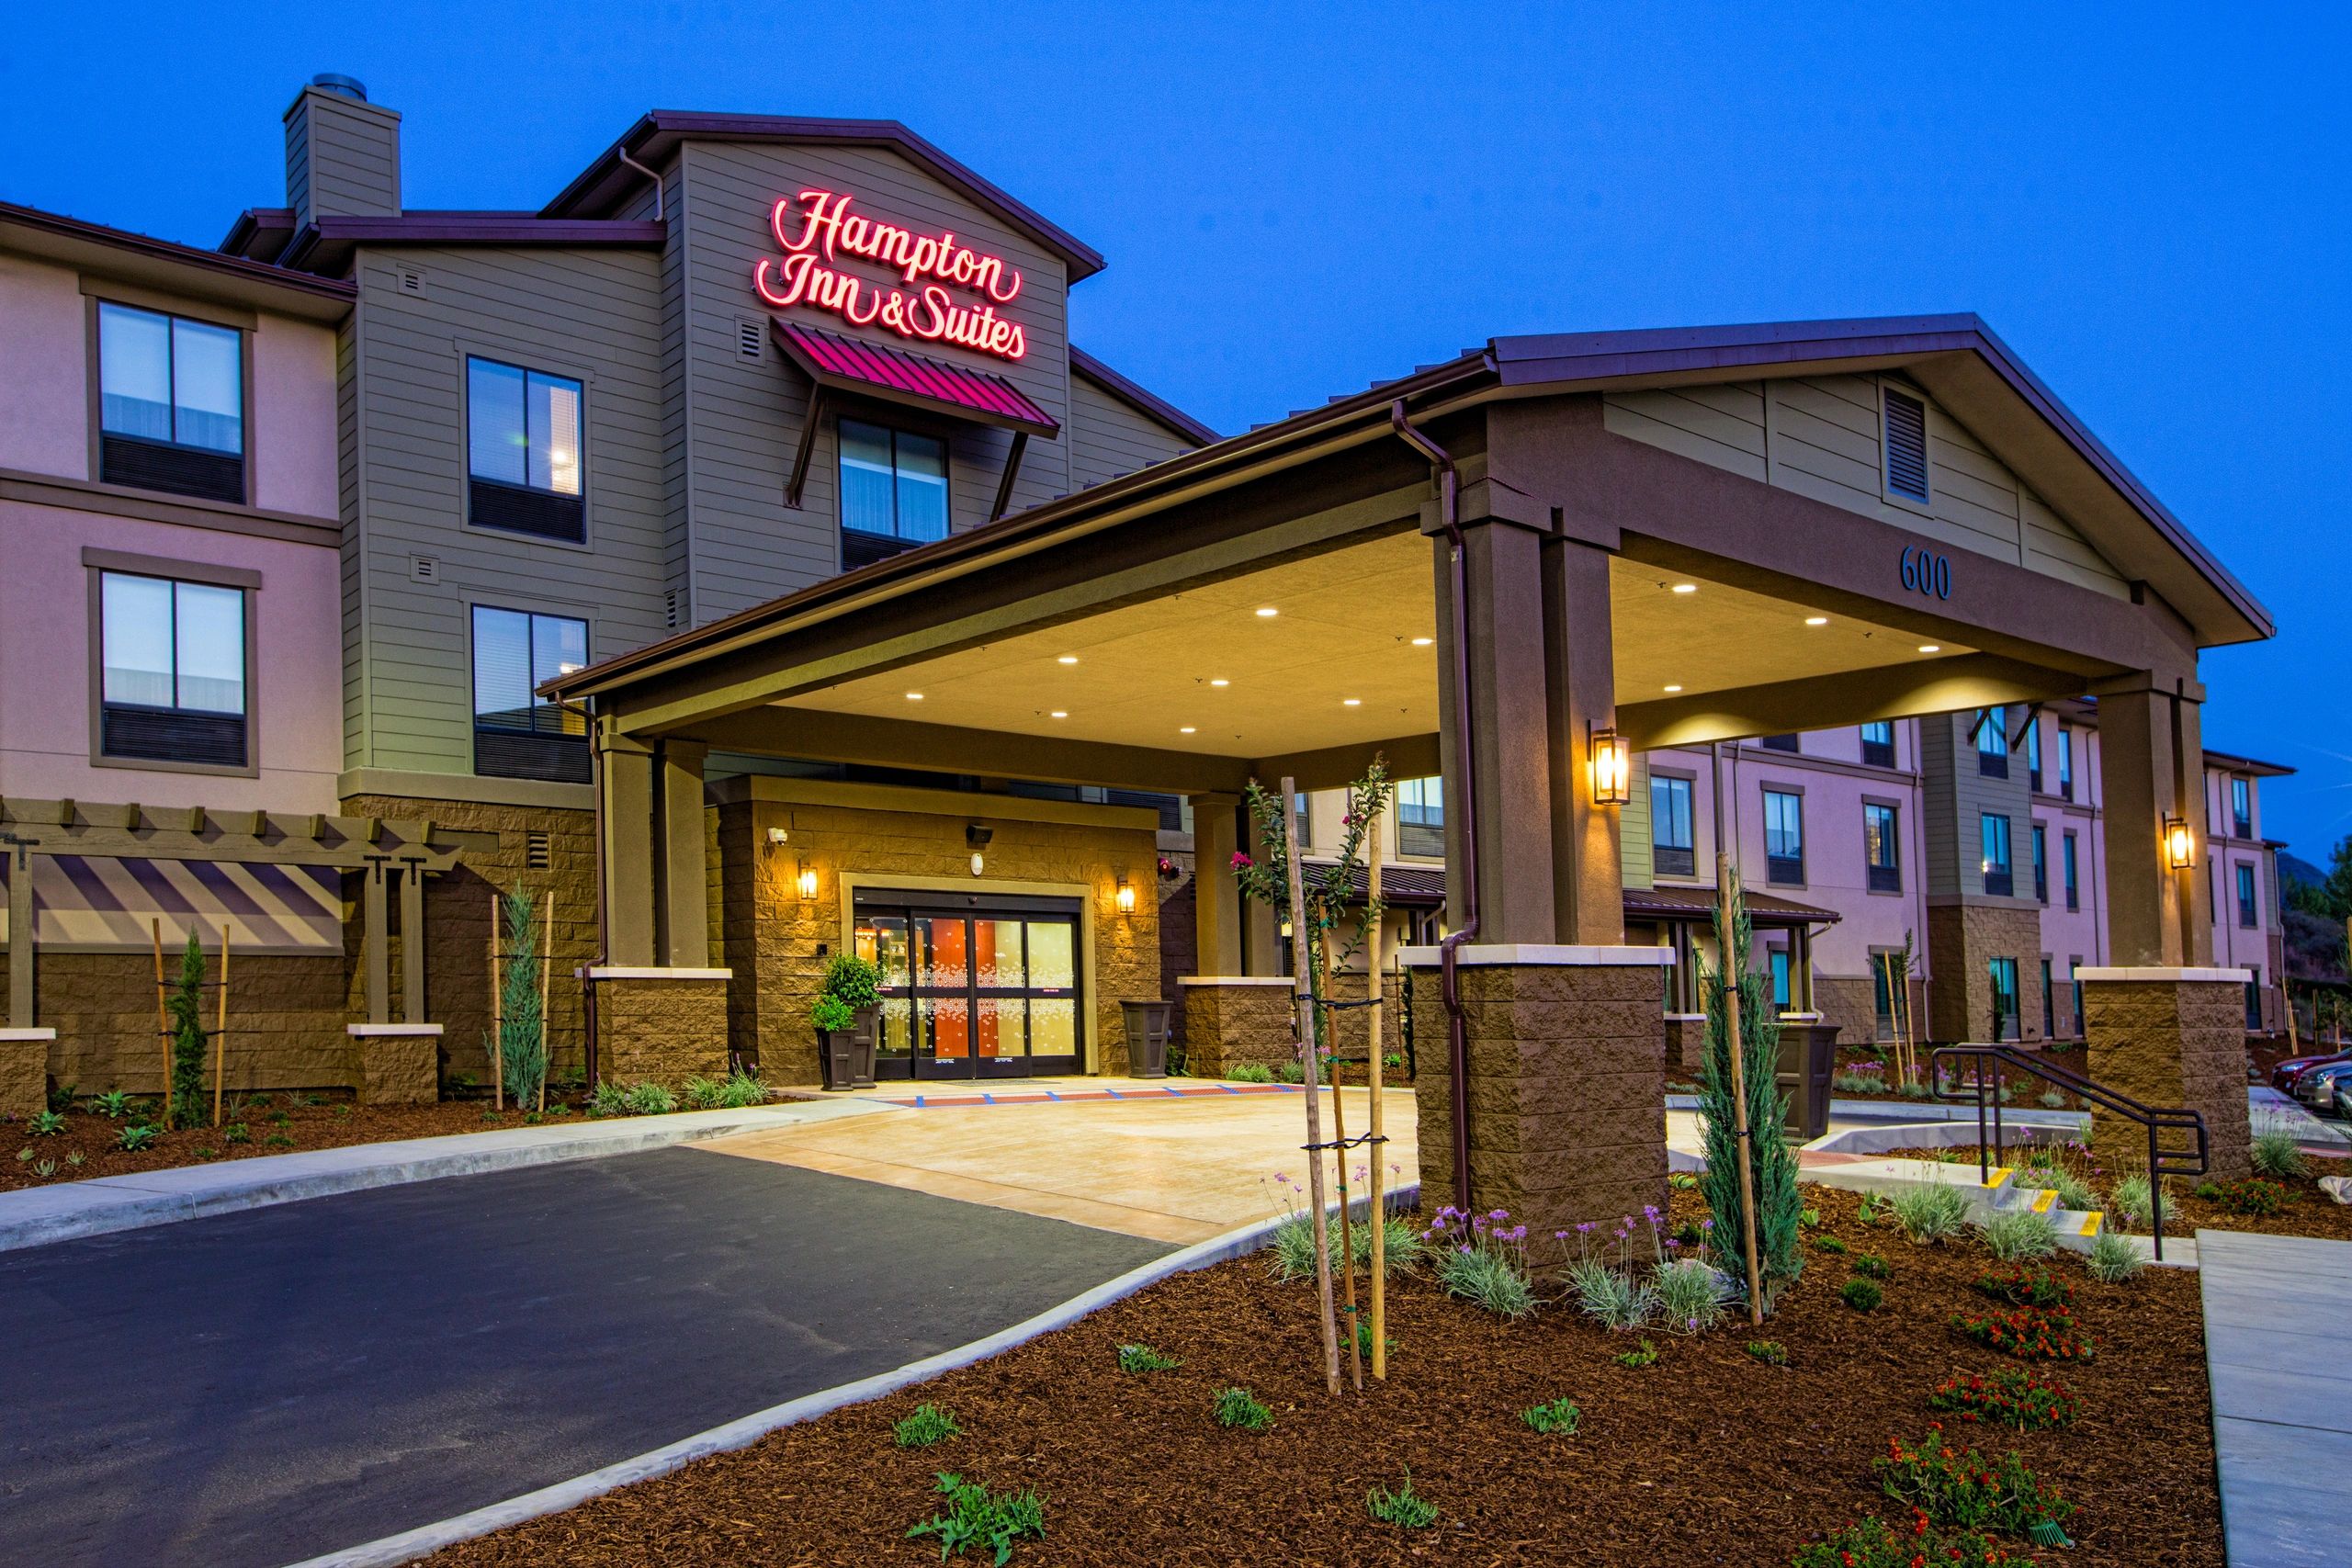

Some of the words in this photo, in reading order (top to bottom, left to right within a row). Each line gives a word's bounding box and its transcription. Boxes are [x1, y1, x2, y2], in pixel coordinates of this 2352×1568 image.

[772, 190, 1022, 302] Hampton
[755, 253, 880, 323] Inn
[881, 291, 913, 336] &
[907, 285, 1026, 358] Suites
[1899, 543, 1952, 601] 600
